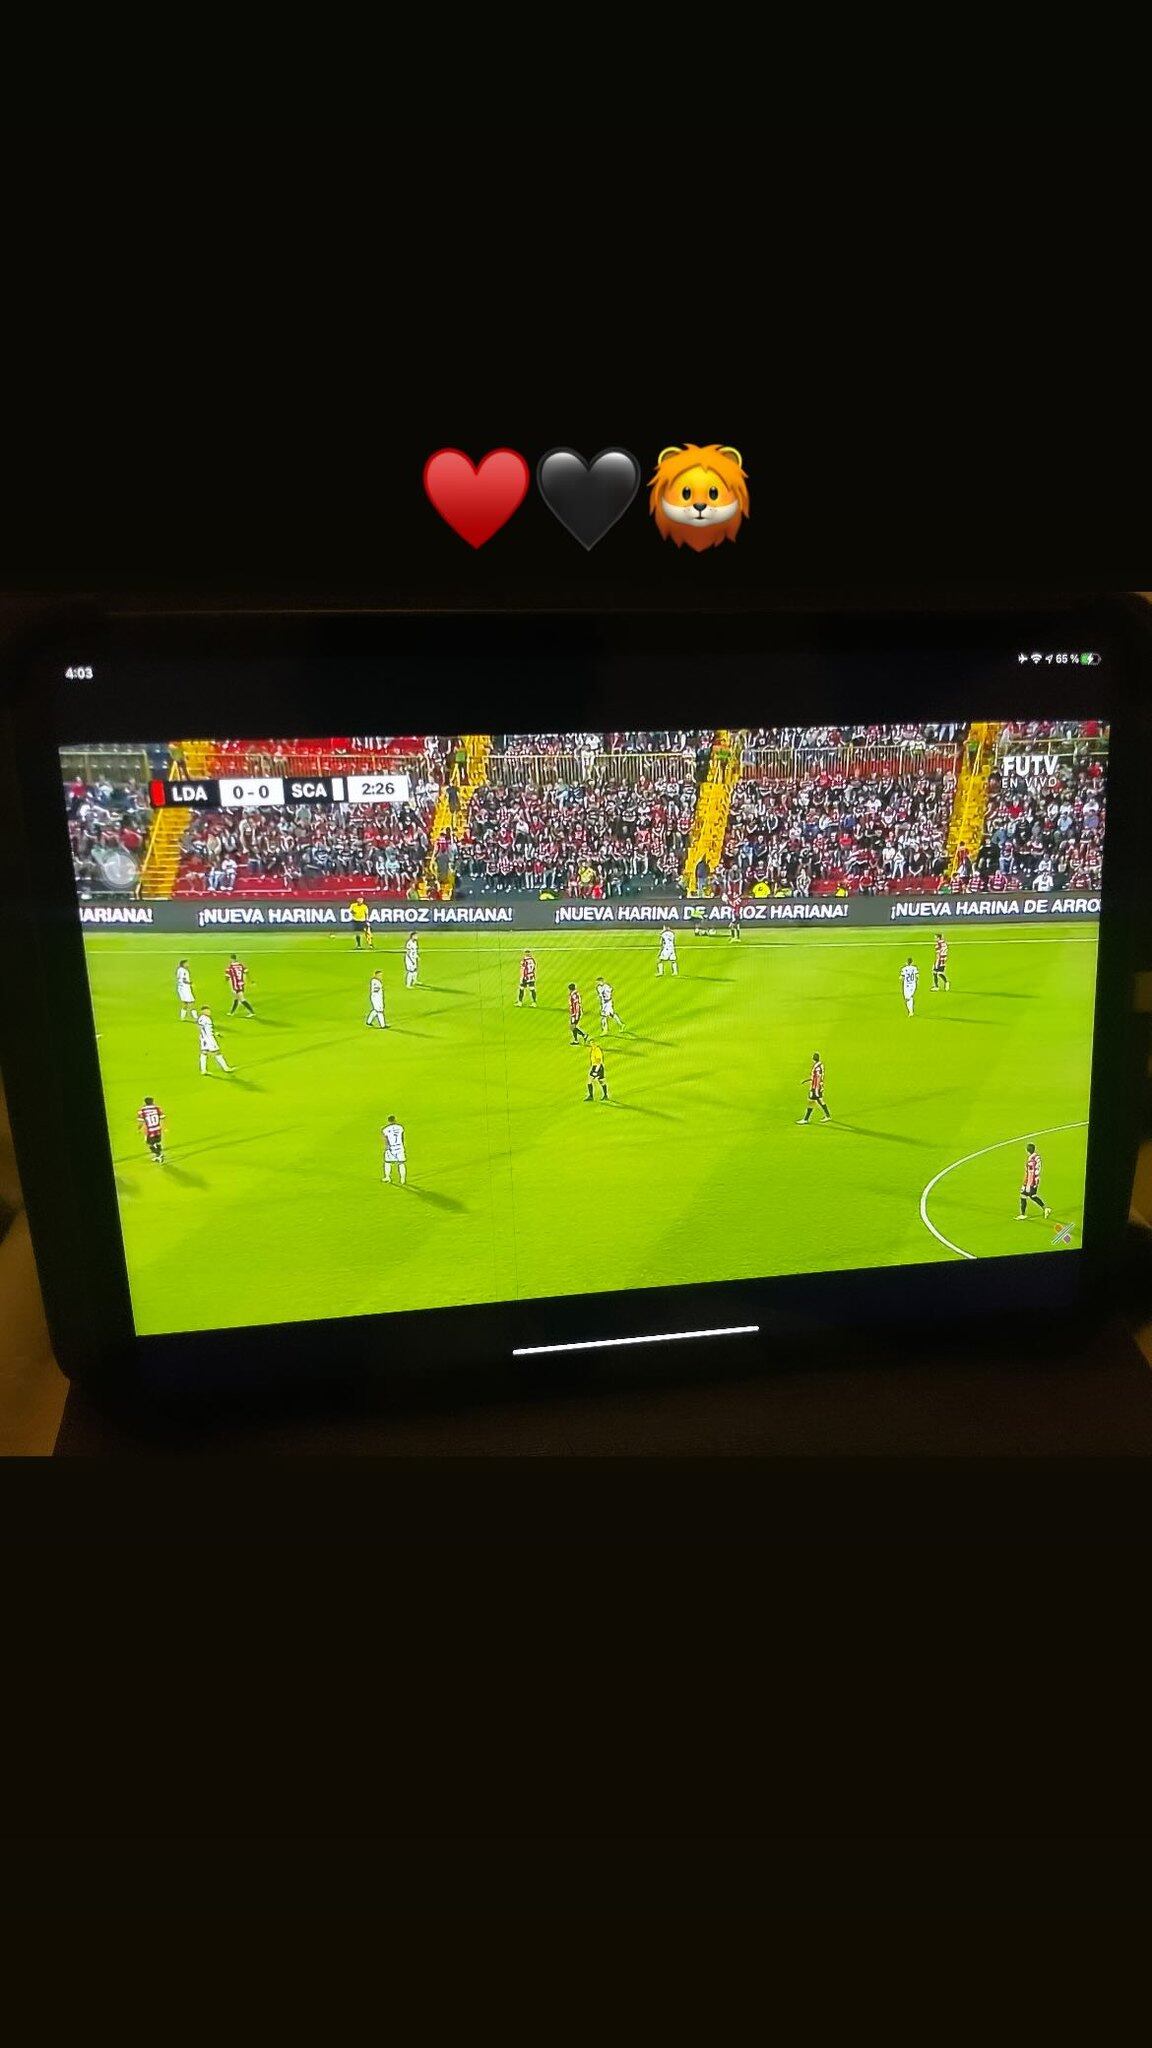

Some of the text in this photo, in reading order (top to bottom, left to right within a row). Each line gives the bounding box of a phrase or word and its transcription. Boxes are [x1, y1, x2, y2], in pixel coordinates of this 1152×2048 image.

[1055, 653, 1080, 664] 65 %
[65, 666, 94, 680] 4:03
[1003, 755, 1059, 777] FUTV
[172, 786, 208, 802] LDA
[233, 785, 244, 799] 0
[260, 784, 270, 798] 0
[291, 782, 327, 799] SCA
[361, 782, 395, 796] 2:26
[1001, 776, 1057, 789] EN VIVO
[199, 908, 264, 927] ¡NUEVA
[268, 908, 337, 923] HARINA
[369, 907, 430, 923] ARROZ
[433, 907, 513, 923] HARIANA!
[555, 906, 614, 924] ¡NUEVA
[617, 905, 679, 921] HARINA
[770, 904, 849, 919] HARIANA!
[891, 898, 1101, 920] ¡NUEVA HARINA DE ARRO
